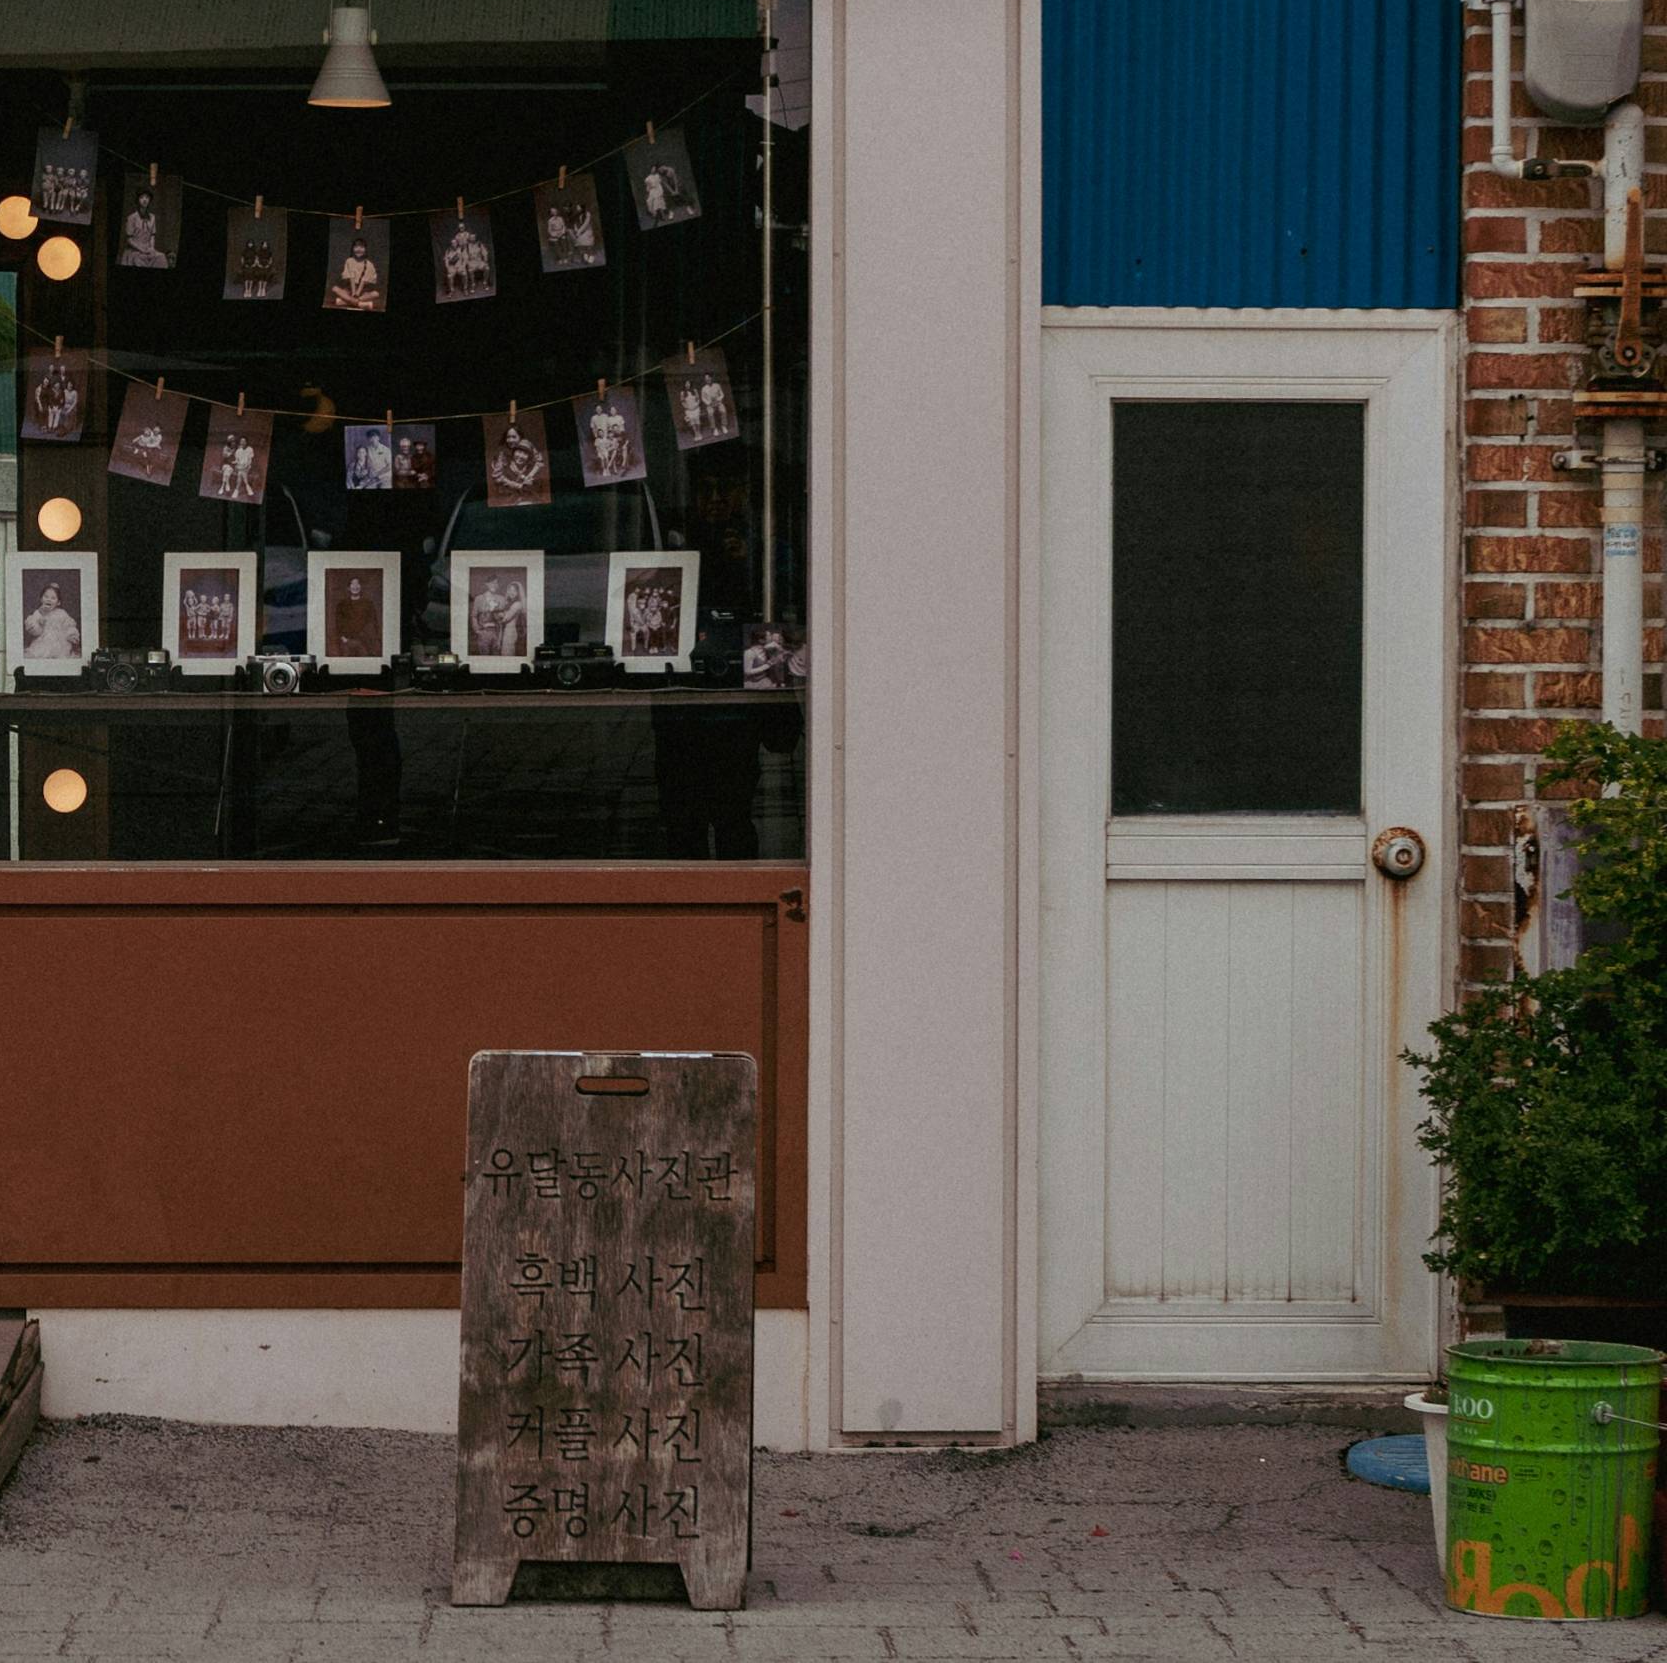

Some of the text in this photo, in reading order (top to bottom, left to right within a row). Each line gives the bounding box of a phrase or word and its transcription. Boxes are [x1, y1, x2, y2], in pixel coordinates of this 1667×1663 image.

[482, 1147, 739, 1202] 유달동사진관
[509, 1252, 706, 1311] 흑백 사진
[506, 1331, 705, 1388] 가족 사진
[506, 1405, 703, 1464] 커플 사진
[503, 1483, 701, 1539] 증명 사진
